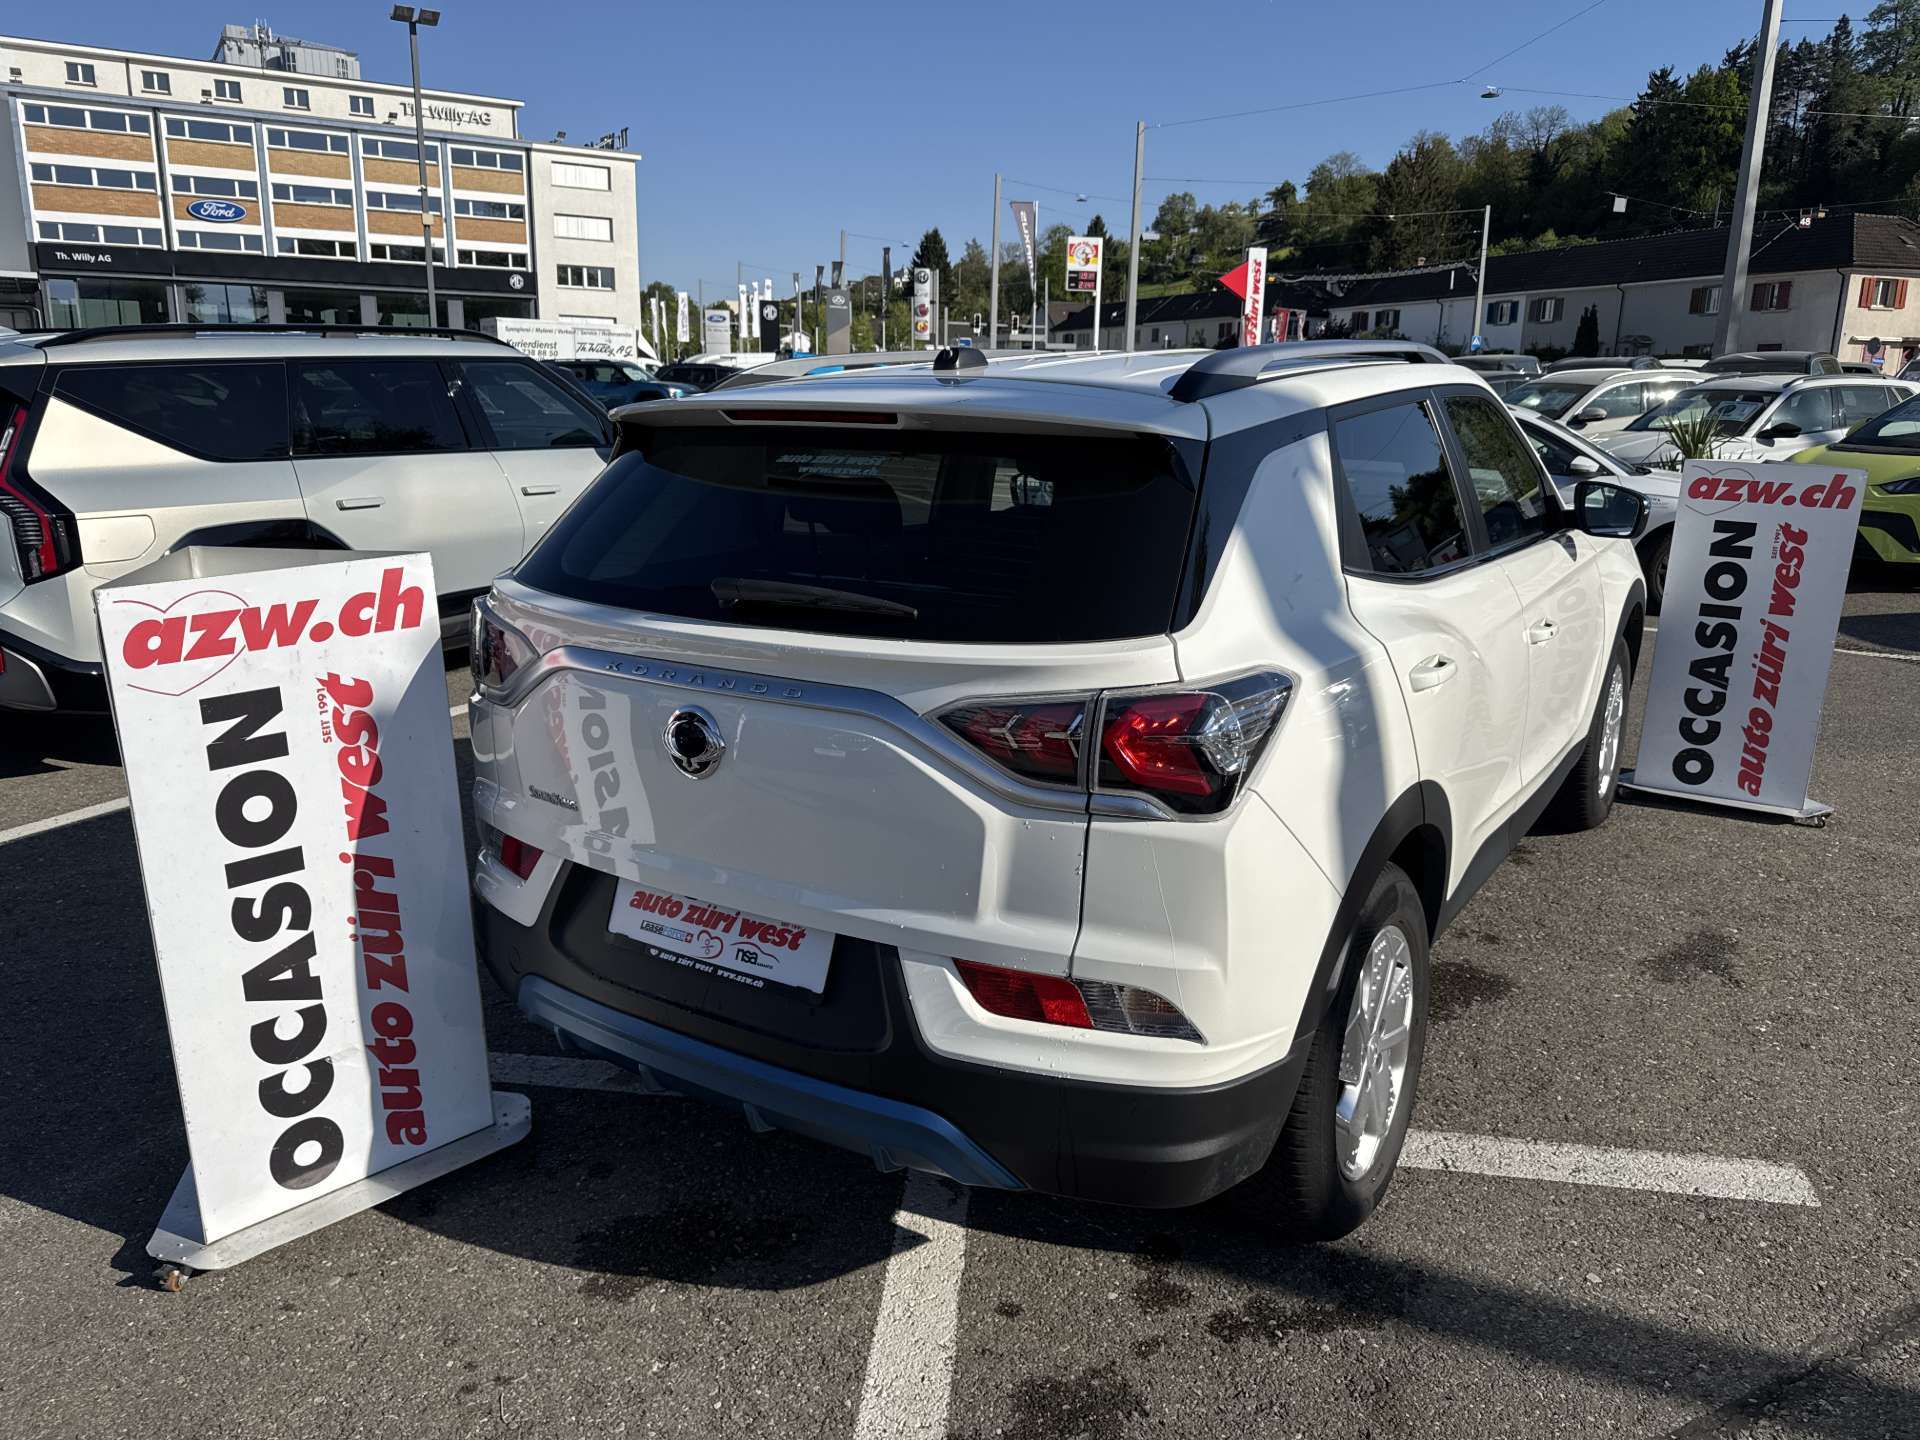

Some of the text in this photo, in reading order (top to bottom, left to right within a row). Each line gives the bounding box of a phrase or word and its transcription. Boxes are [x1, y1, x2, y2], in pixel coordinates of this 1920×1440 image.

[428, 105, 464, 125] Willy
[467, 111, 491, 125] AG
[200, 202, 236, 218] Ford
[55, 251, 112, 263] Th. Willy AG
[506, 339, 558, 349] Kurierdienst
[1688, 474, 1857, 509] azw.ch
[122, 567, 425, 669] azw.ch
[1672, 519, 1758, 786] OCCASION
[1738, 522, 1808, 797] auto züri west
[605, 662, 804, 699] KORANDO
[316, 687, 333, 744] SEIT 1991
[315, 671, 428, 1147] auto züri west
[629, 890, 807, 951] auto züri west
[199, 686, 345, 1190] OCCASION
[735, 948, 758, 965] nsa
